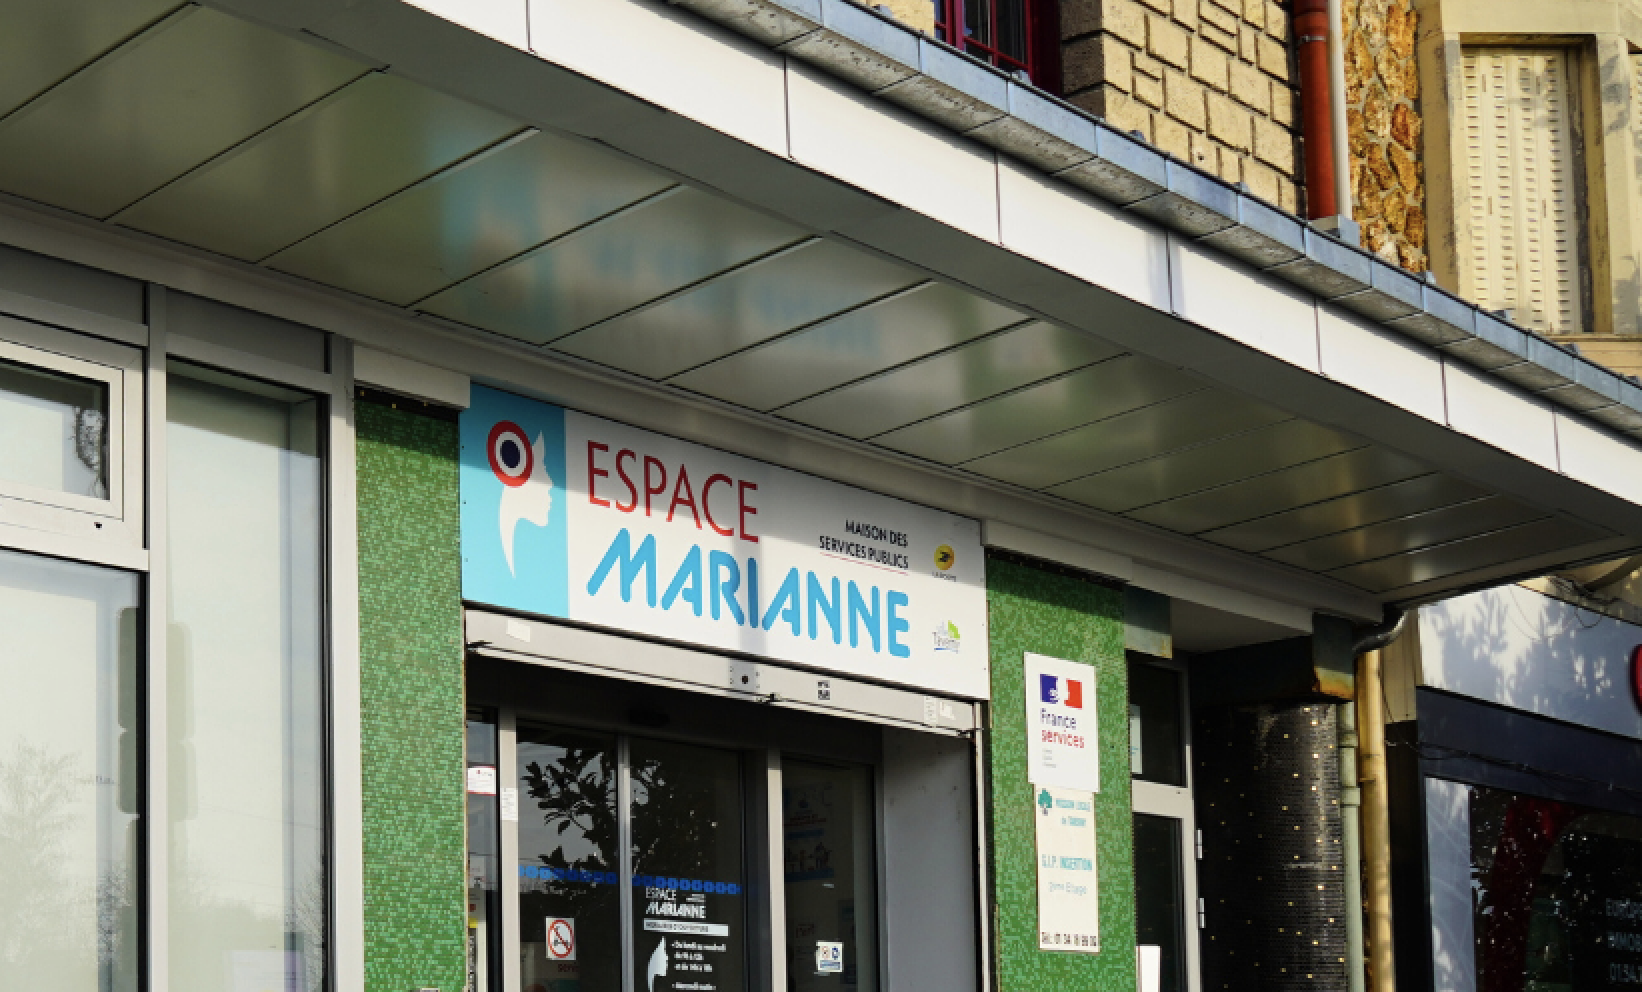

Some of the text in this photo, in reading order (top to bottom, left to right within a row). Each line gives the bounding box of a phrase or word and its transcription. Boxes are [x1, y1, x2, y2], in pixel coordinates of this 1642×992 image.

[587, 439, 759, 543] ESPACE
[844, 519, 909, 549] MAISON DES
[819, 535, 909, 569] SERVICES PUBLICS
[587, 527, 910, 659] MARIANNE
[1040, 708, 1077, 730] France
[1041, 730, 1085, 749] services
[645, 886, 677, 901] ESPACE
[645, 901, 707, 919] MARIANNE
